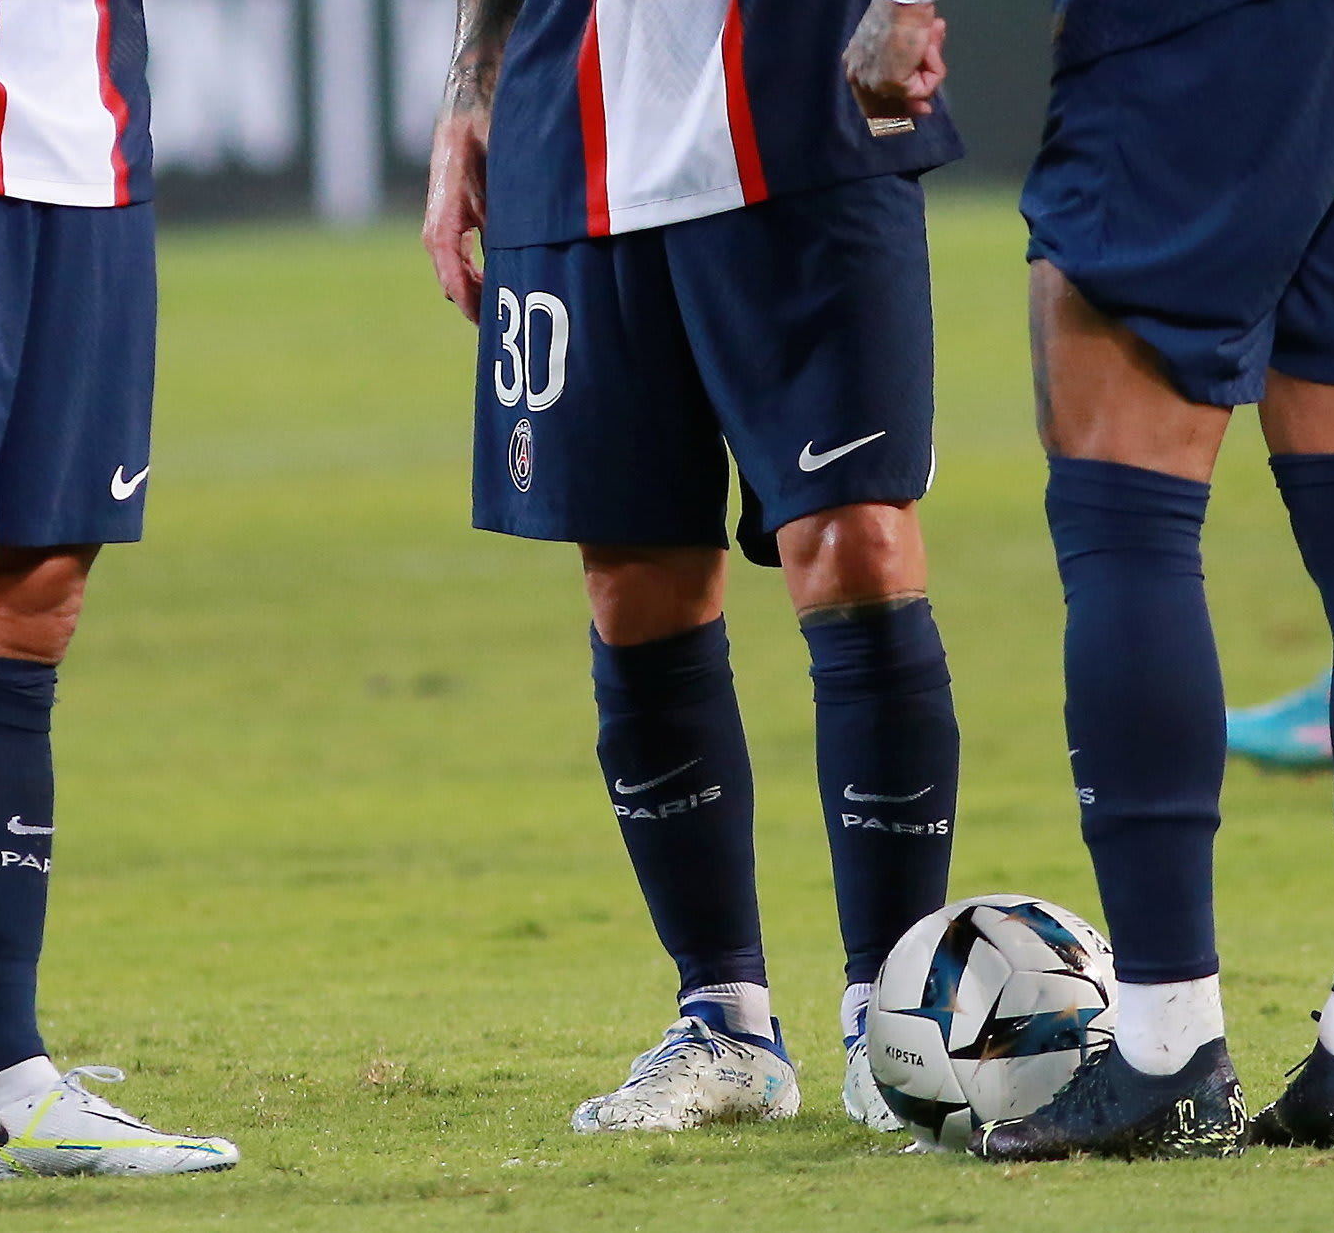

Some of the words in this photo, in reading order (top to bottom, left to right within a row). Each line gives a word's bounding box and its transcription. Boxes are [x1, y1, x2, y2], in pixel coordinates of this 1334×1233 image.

[494, 286, 569, 411] 30
[613, 785, 722, 819] PARIS
[841, 813, 949, 836] PARIS
[885, 1043, 925, 1068] KIPSTA
